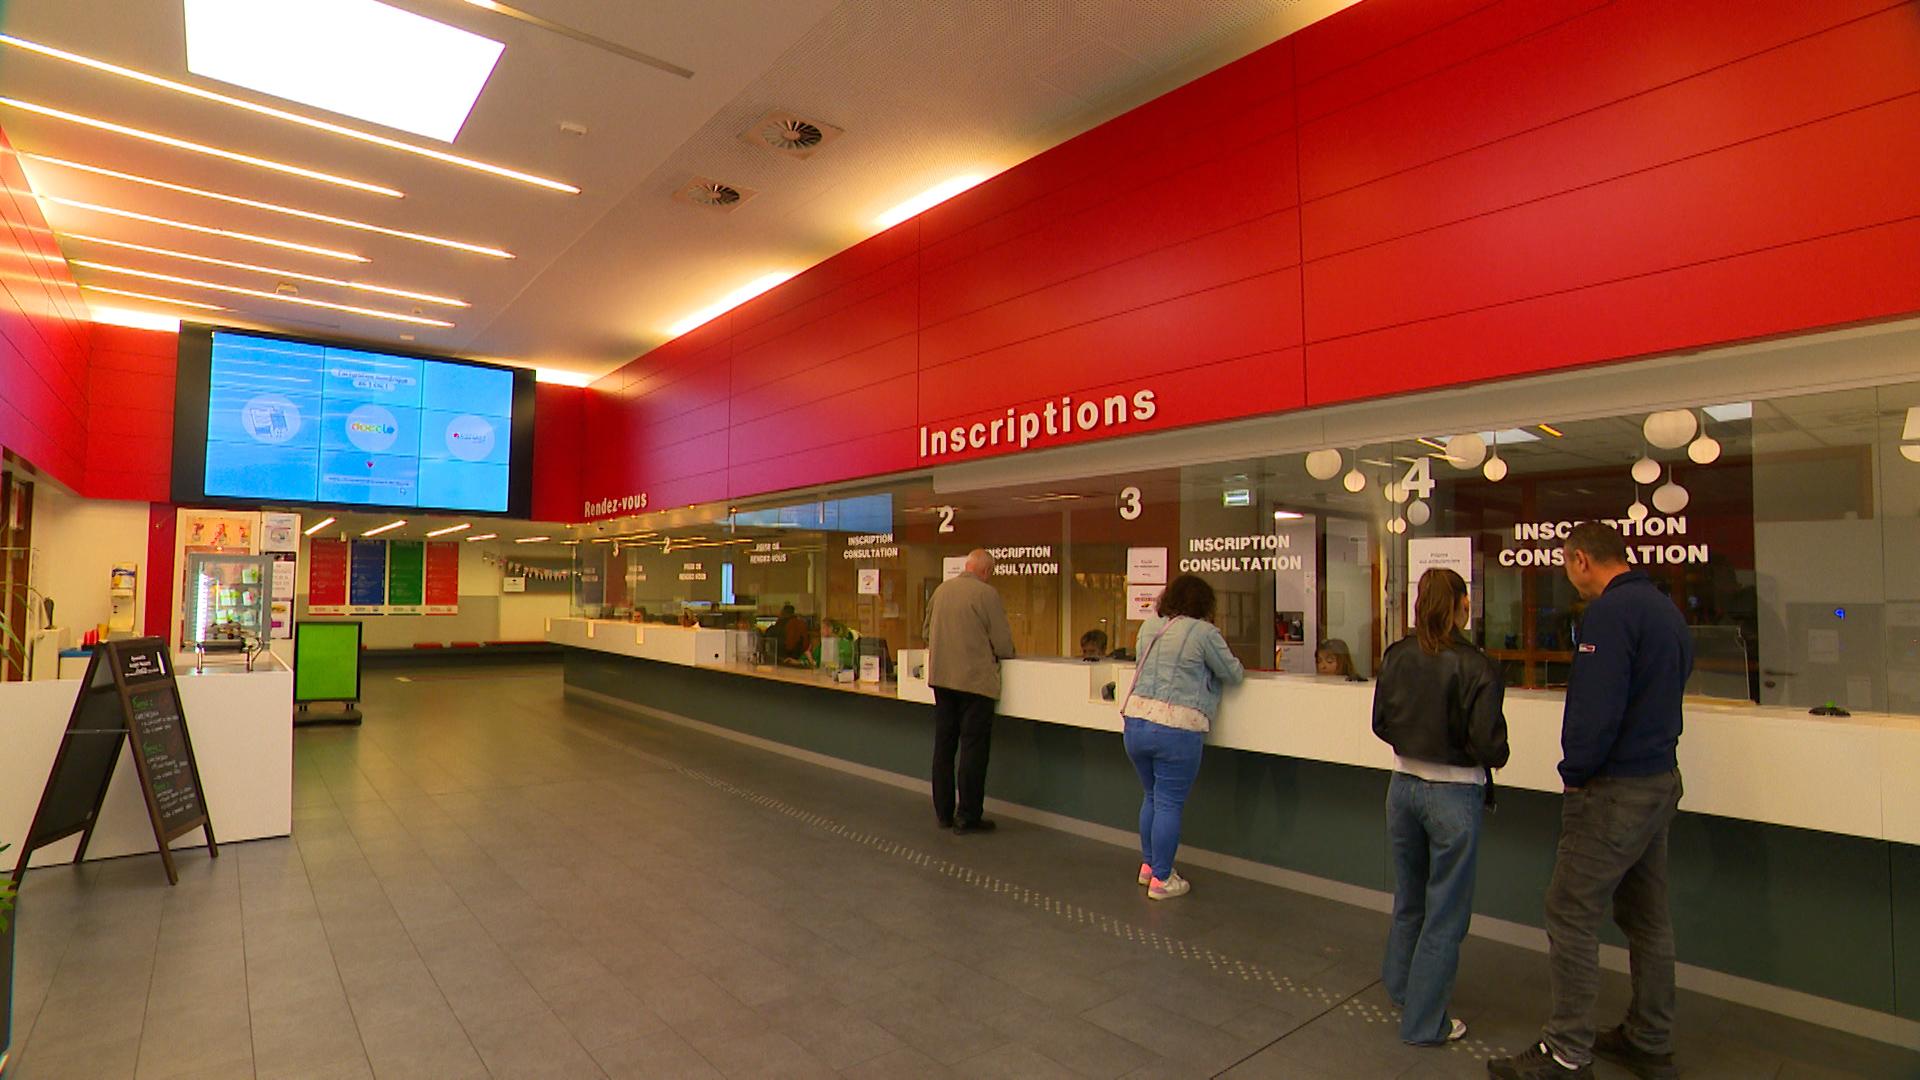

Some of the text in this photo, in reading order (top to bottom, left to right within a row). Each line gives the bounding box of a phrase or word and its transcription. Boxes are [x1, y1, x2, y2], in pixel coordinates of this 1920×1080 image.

[920, 389, 1157, 458] Inscriptions
[1402, 457, 1435, 498] 4
[584, 493, 648, 518] Rendez-vous
[1119, 486, 1142, 520] 3
[939, 505, 955, 533] 2
[1514, 515, 1688, 541] INSCTION
[662, 537, 672, 554] 2
[847, 533, 894, 546] INSCRIPTION
[1189, 535, 1291, 552] INSCRIPTION
[843, 547, 899, 560] CONSULTATION
[986, 545, 1051, 559] NSCRIPTION
[1498, 544, 1709, 567] CONSATION
[993, 562, 1059, 576] NSULTATION
[1179, 555, 1303, 573] CONSULTATION
